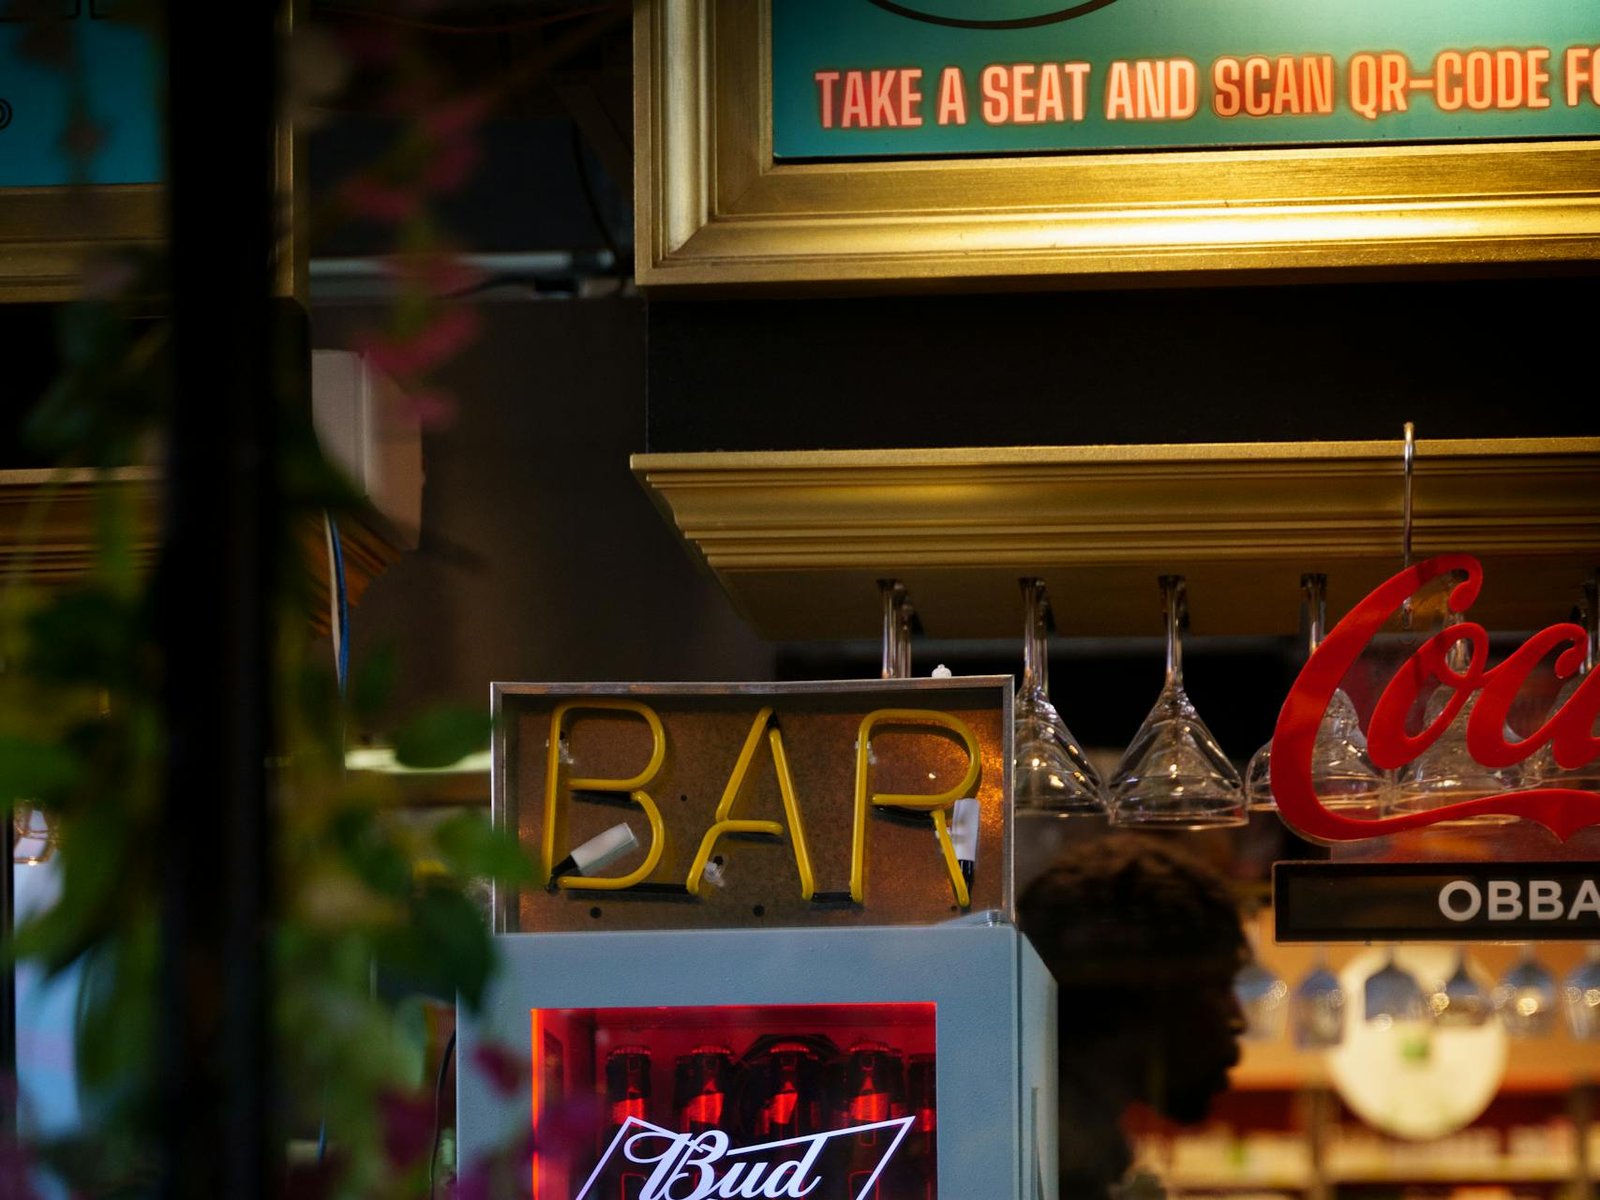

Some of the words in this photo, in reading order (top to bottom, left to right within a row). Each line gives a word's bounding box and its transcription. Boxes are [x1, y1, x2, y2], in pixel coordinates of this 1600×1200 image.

[815, 69, 923, 129] TAKE
[938, 67, 968, 125] A
[982, 62, 1091, 125] SEAT
[1106, 58, 1198, 121] AND
[1213, 55, 1334, 117] SCAN
[1350, 48, 1550, 119] QR-CODE
[1566, 46, 1600, 106] F
[542, 698, 982, 908] BAR
